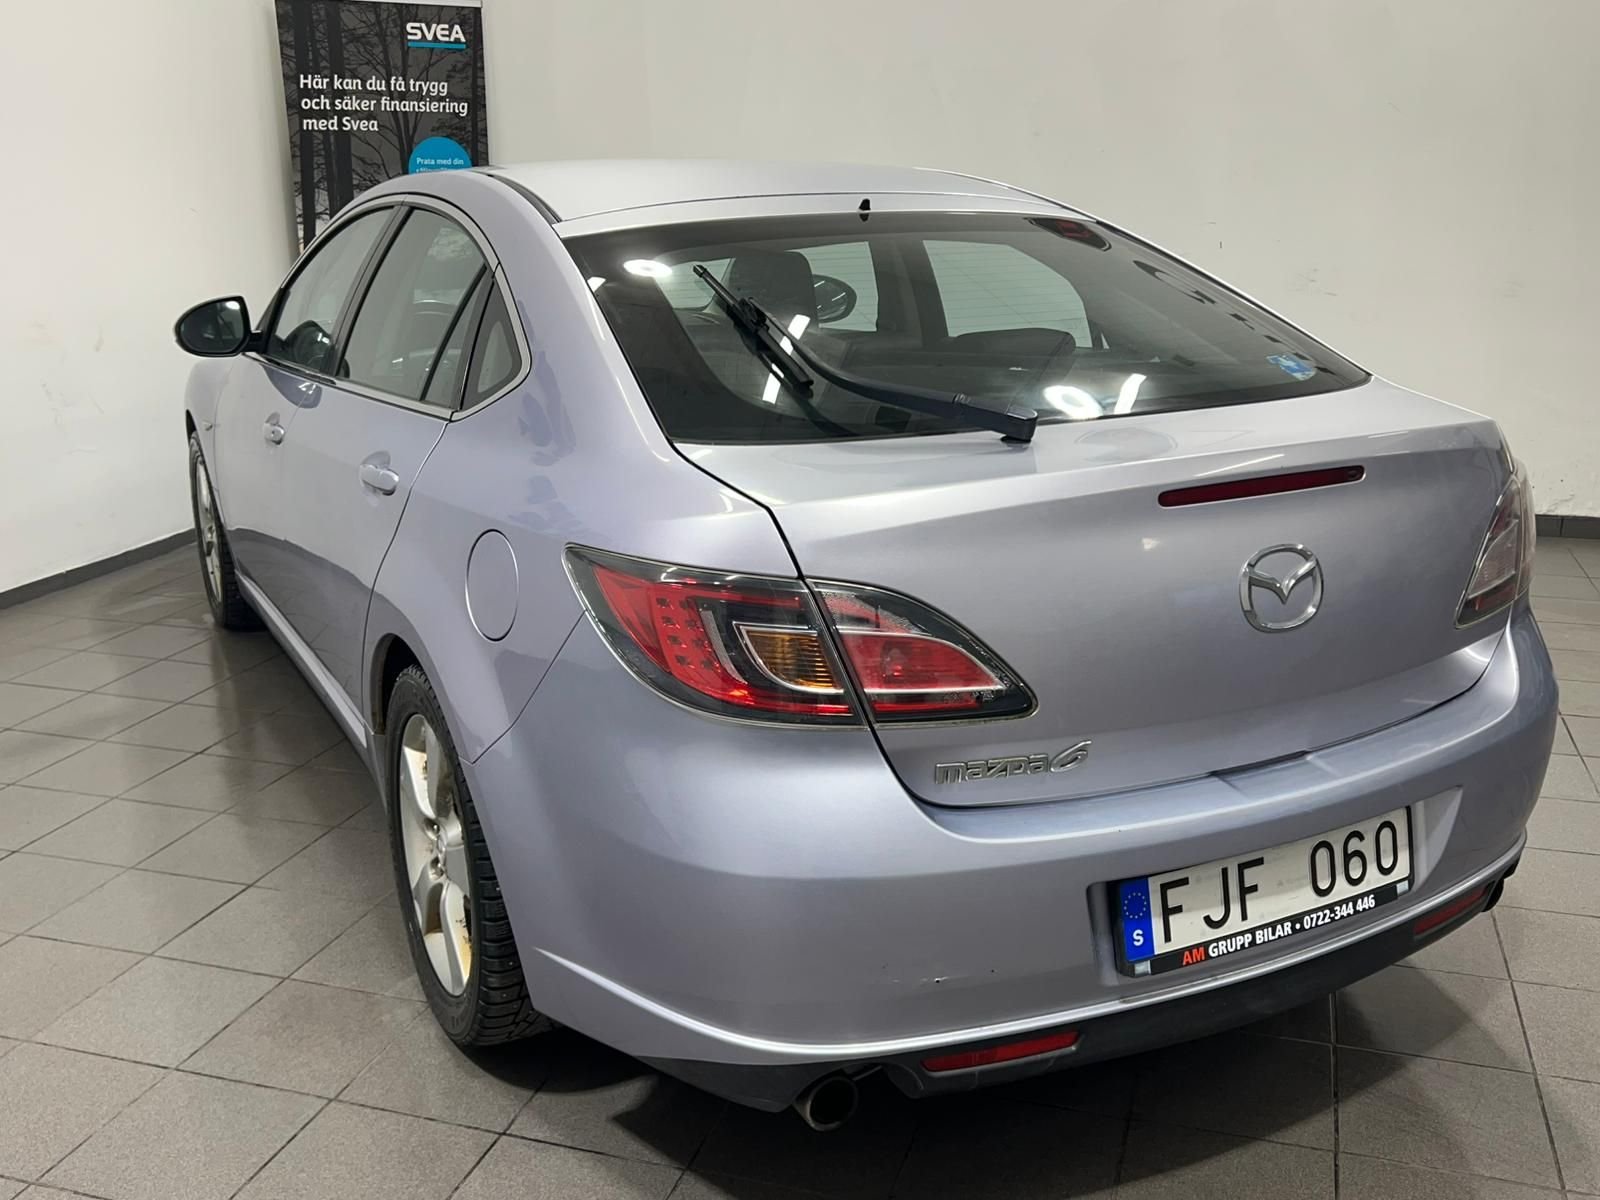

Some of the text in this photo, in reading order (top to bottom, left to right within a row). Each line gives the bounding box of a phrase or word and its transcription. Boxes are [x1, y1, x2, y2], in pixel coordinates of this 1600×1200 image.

[406, 22, 467, 42] SVEA
[300, 74, 448, 96] Här kan du få trygg
[301, 96, 468, 117] och säker finansiering
[303, 116, 379, 132] med Svea
[416, 157, 464, 166] Prata med din
[1159, 820, 1398, 944] FJF 060
[1133, 929, 1144, 946] S
[1182, 946, 1205, 966] AM
[1208, 933, 1253, 958] GRUPP
[1255, 921, 1293, 945] BILAR
[1303, 904, 1354, 930] 0722-344
[1356, 894, 1376, 915] 446
